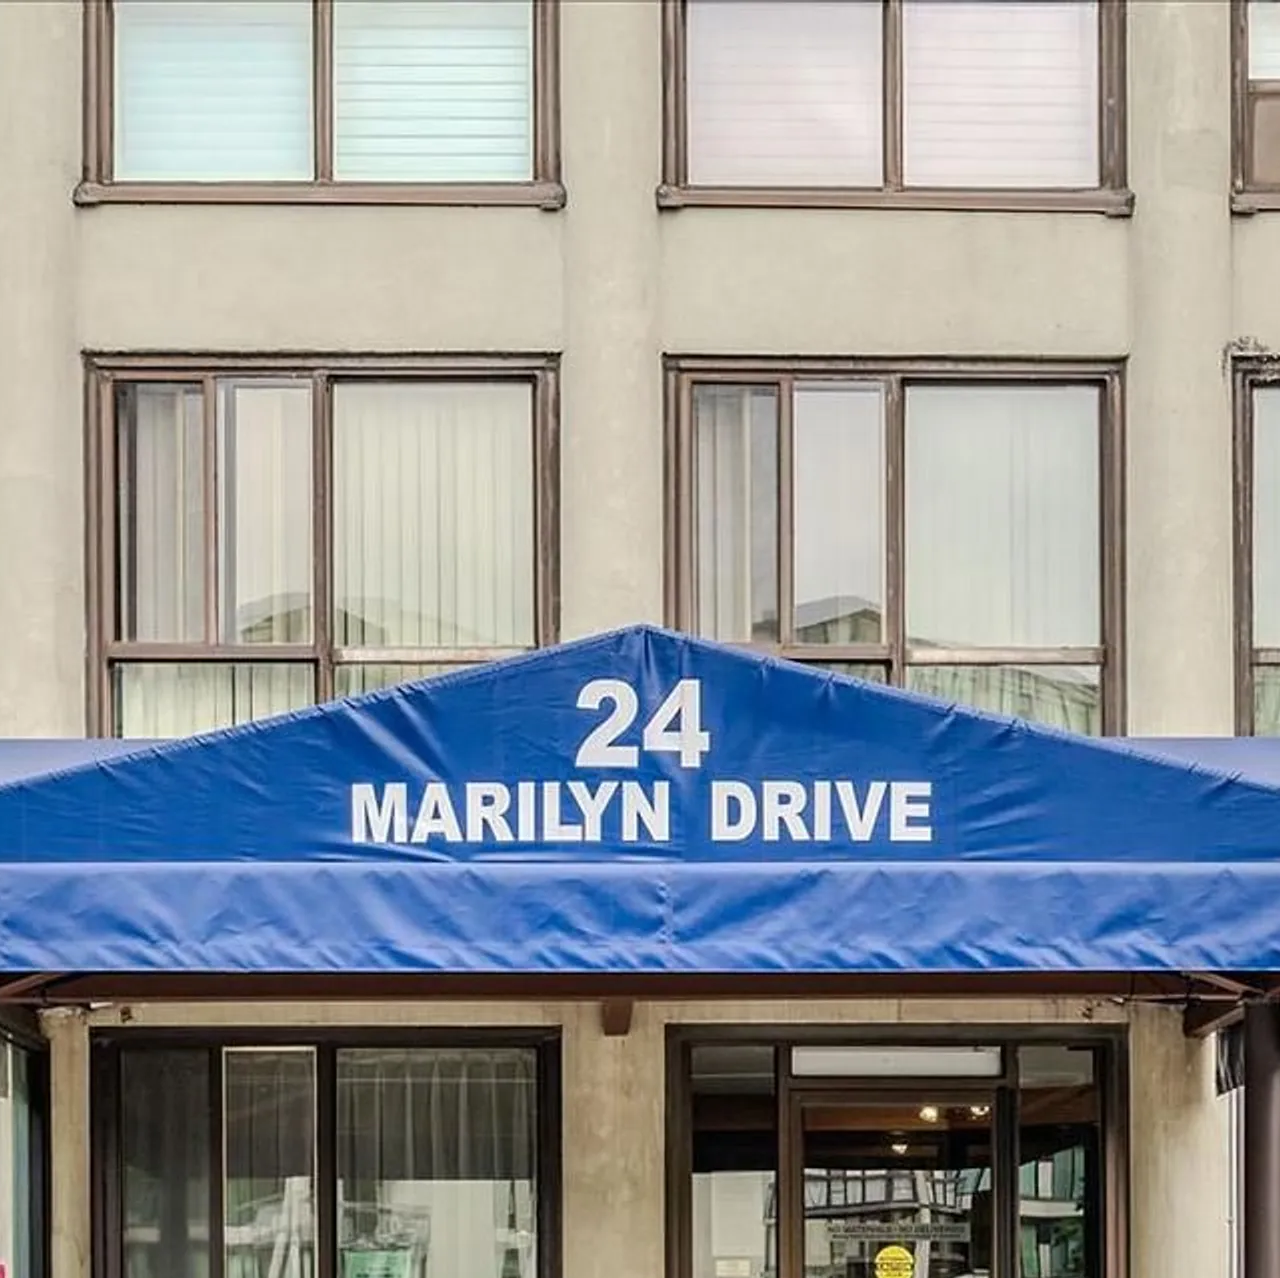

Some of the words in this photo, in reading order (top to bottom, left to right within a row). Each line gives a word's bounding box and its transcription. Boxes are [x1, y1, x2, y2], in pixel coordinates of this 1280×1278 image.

[575, 679, 710, 768] 24
[351, 781, 670, 843] MARILYN
[711, 780, 933, 843] DRIVE
